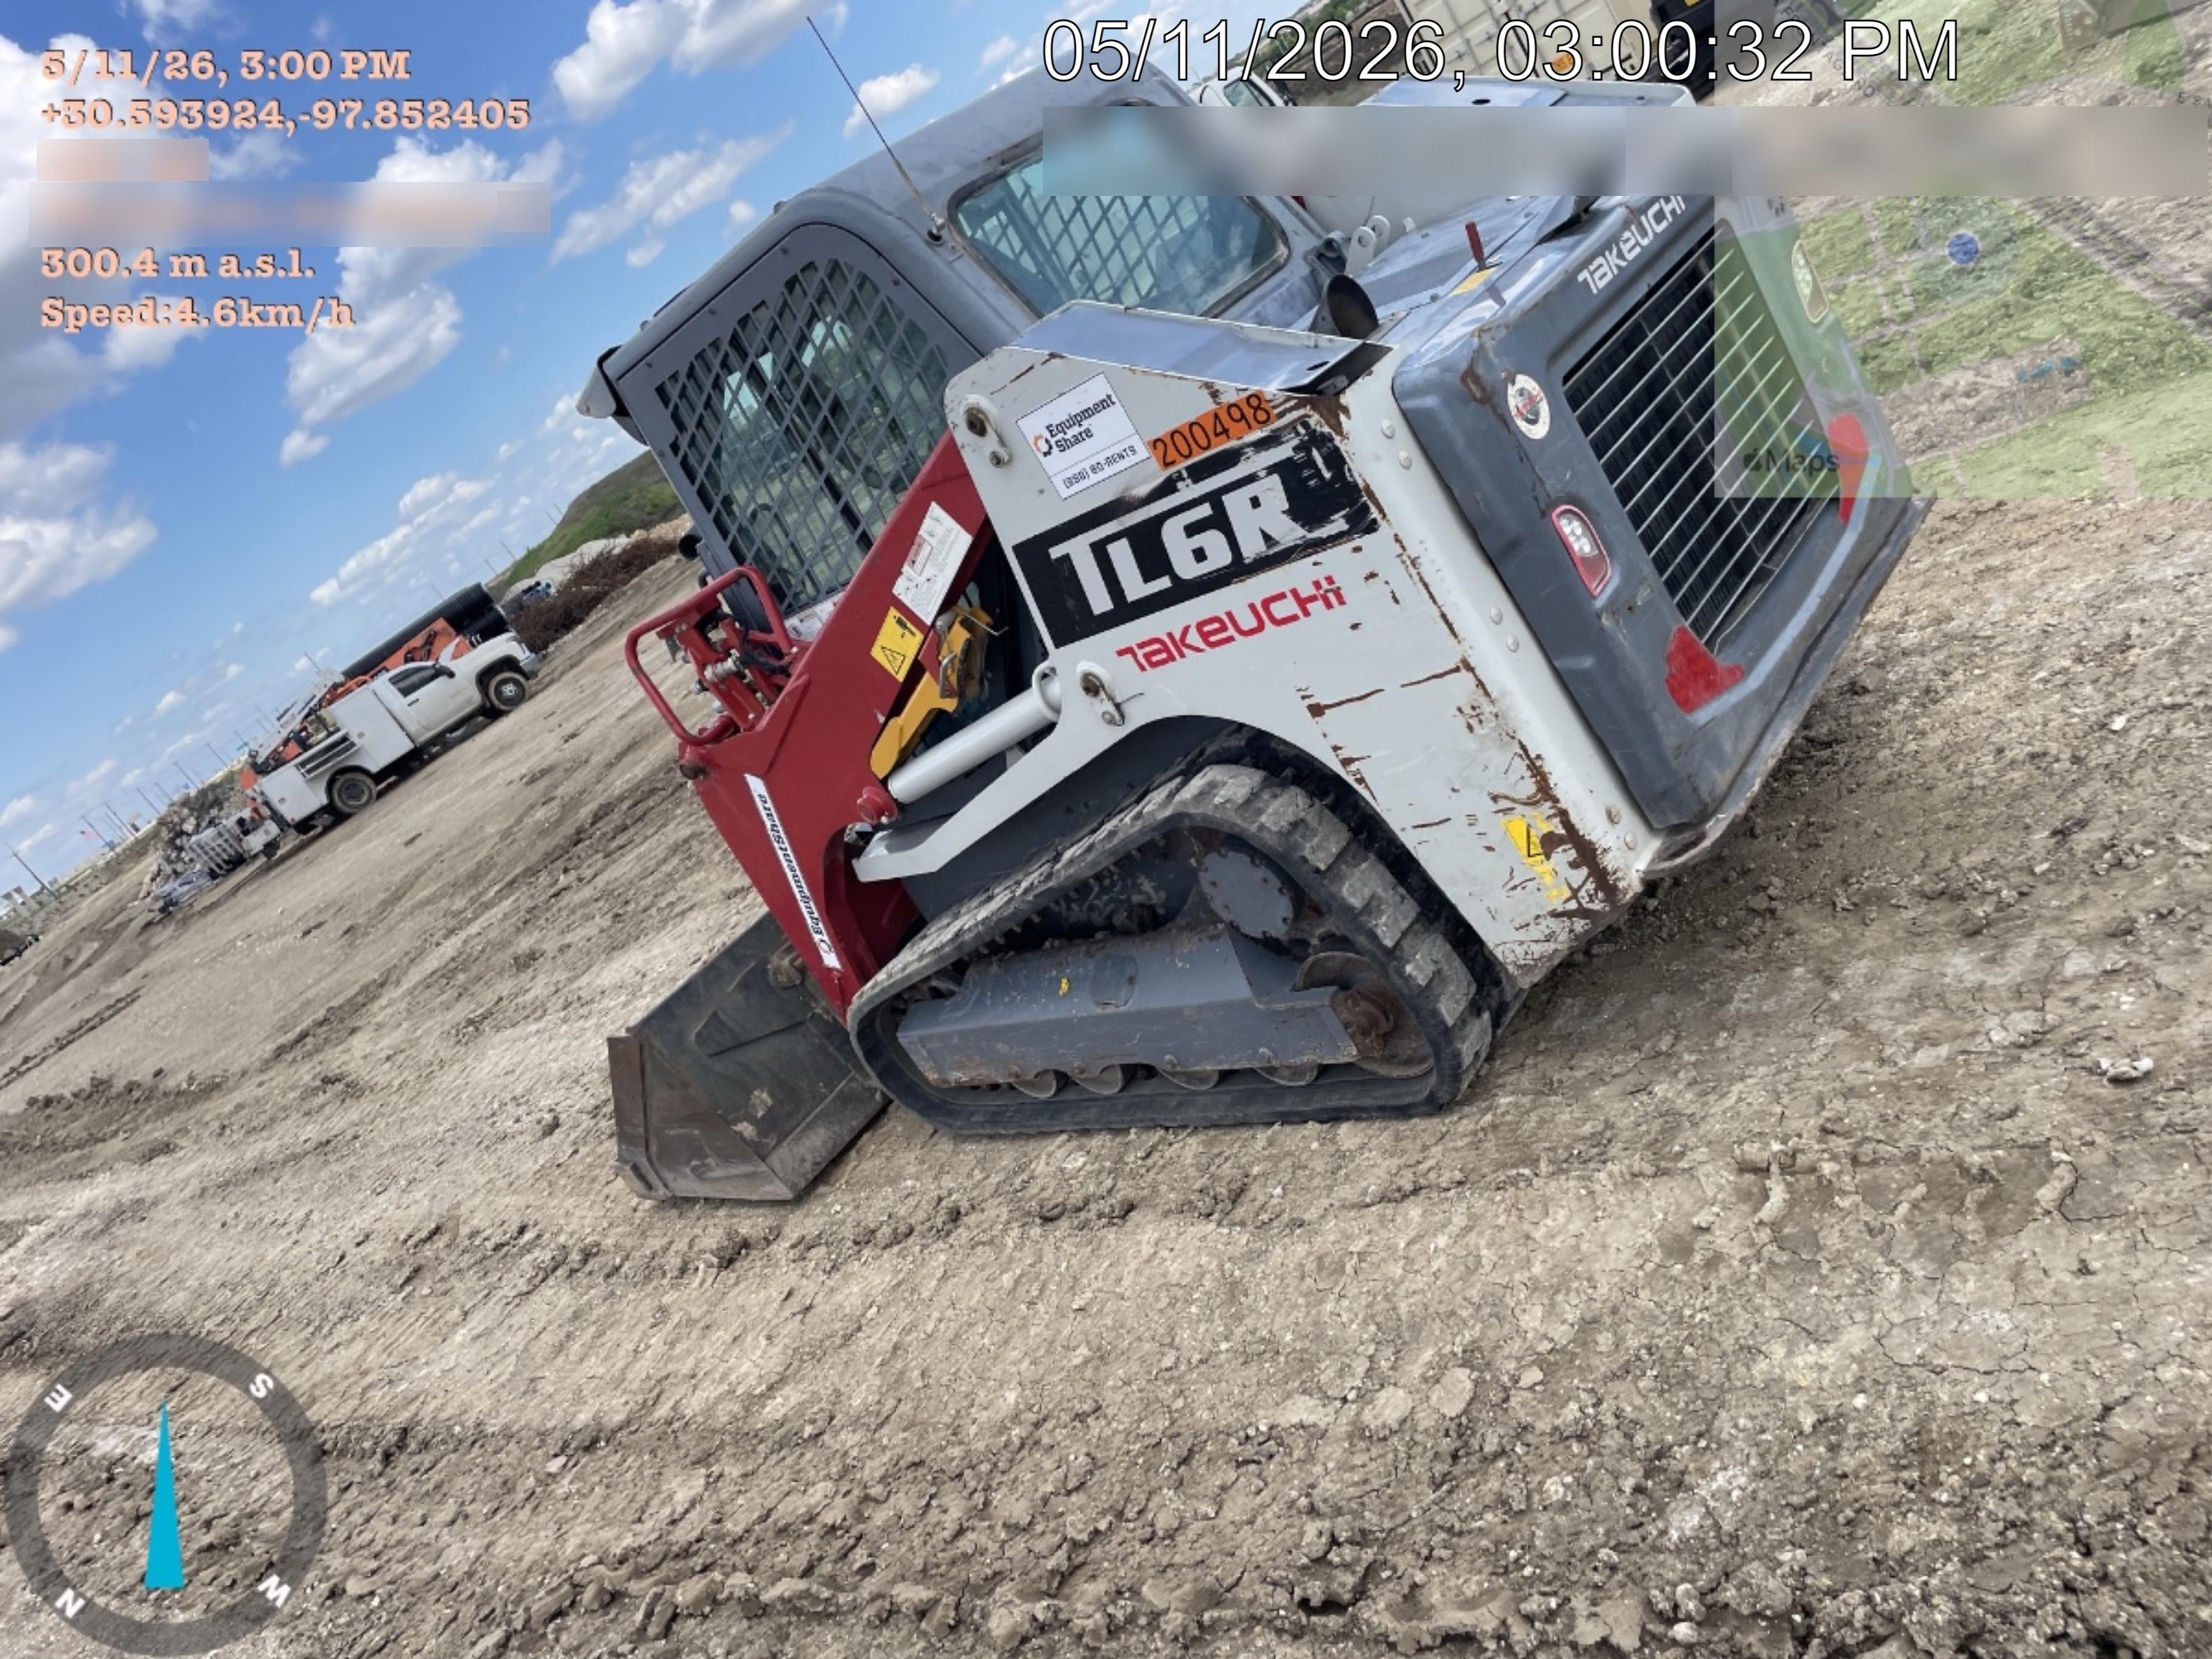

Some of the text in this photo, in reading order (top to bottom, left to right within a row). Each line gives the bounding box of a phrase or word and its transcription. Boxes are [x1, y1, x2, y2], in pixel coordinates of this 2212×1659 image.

[1045, 393, 1116, 439] Equipment
[1054, 427, 1094, 453] Share
[1153, 393, 1271, 468] 200498
[1048, 474, 1310, 616] TL6R
